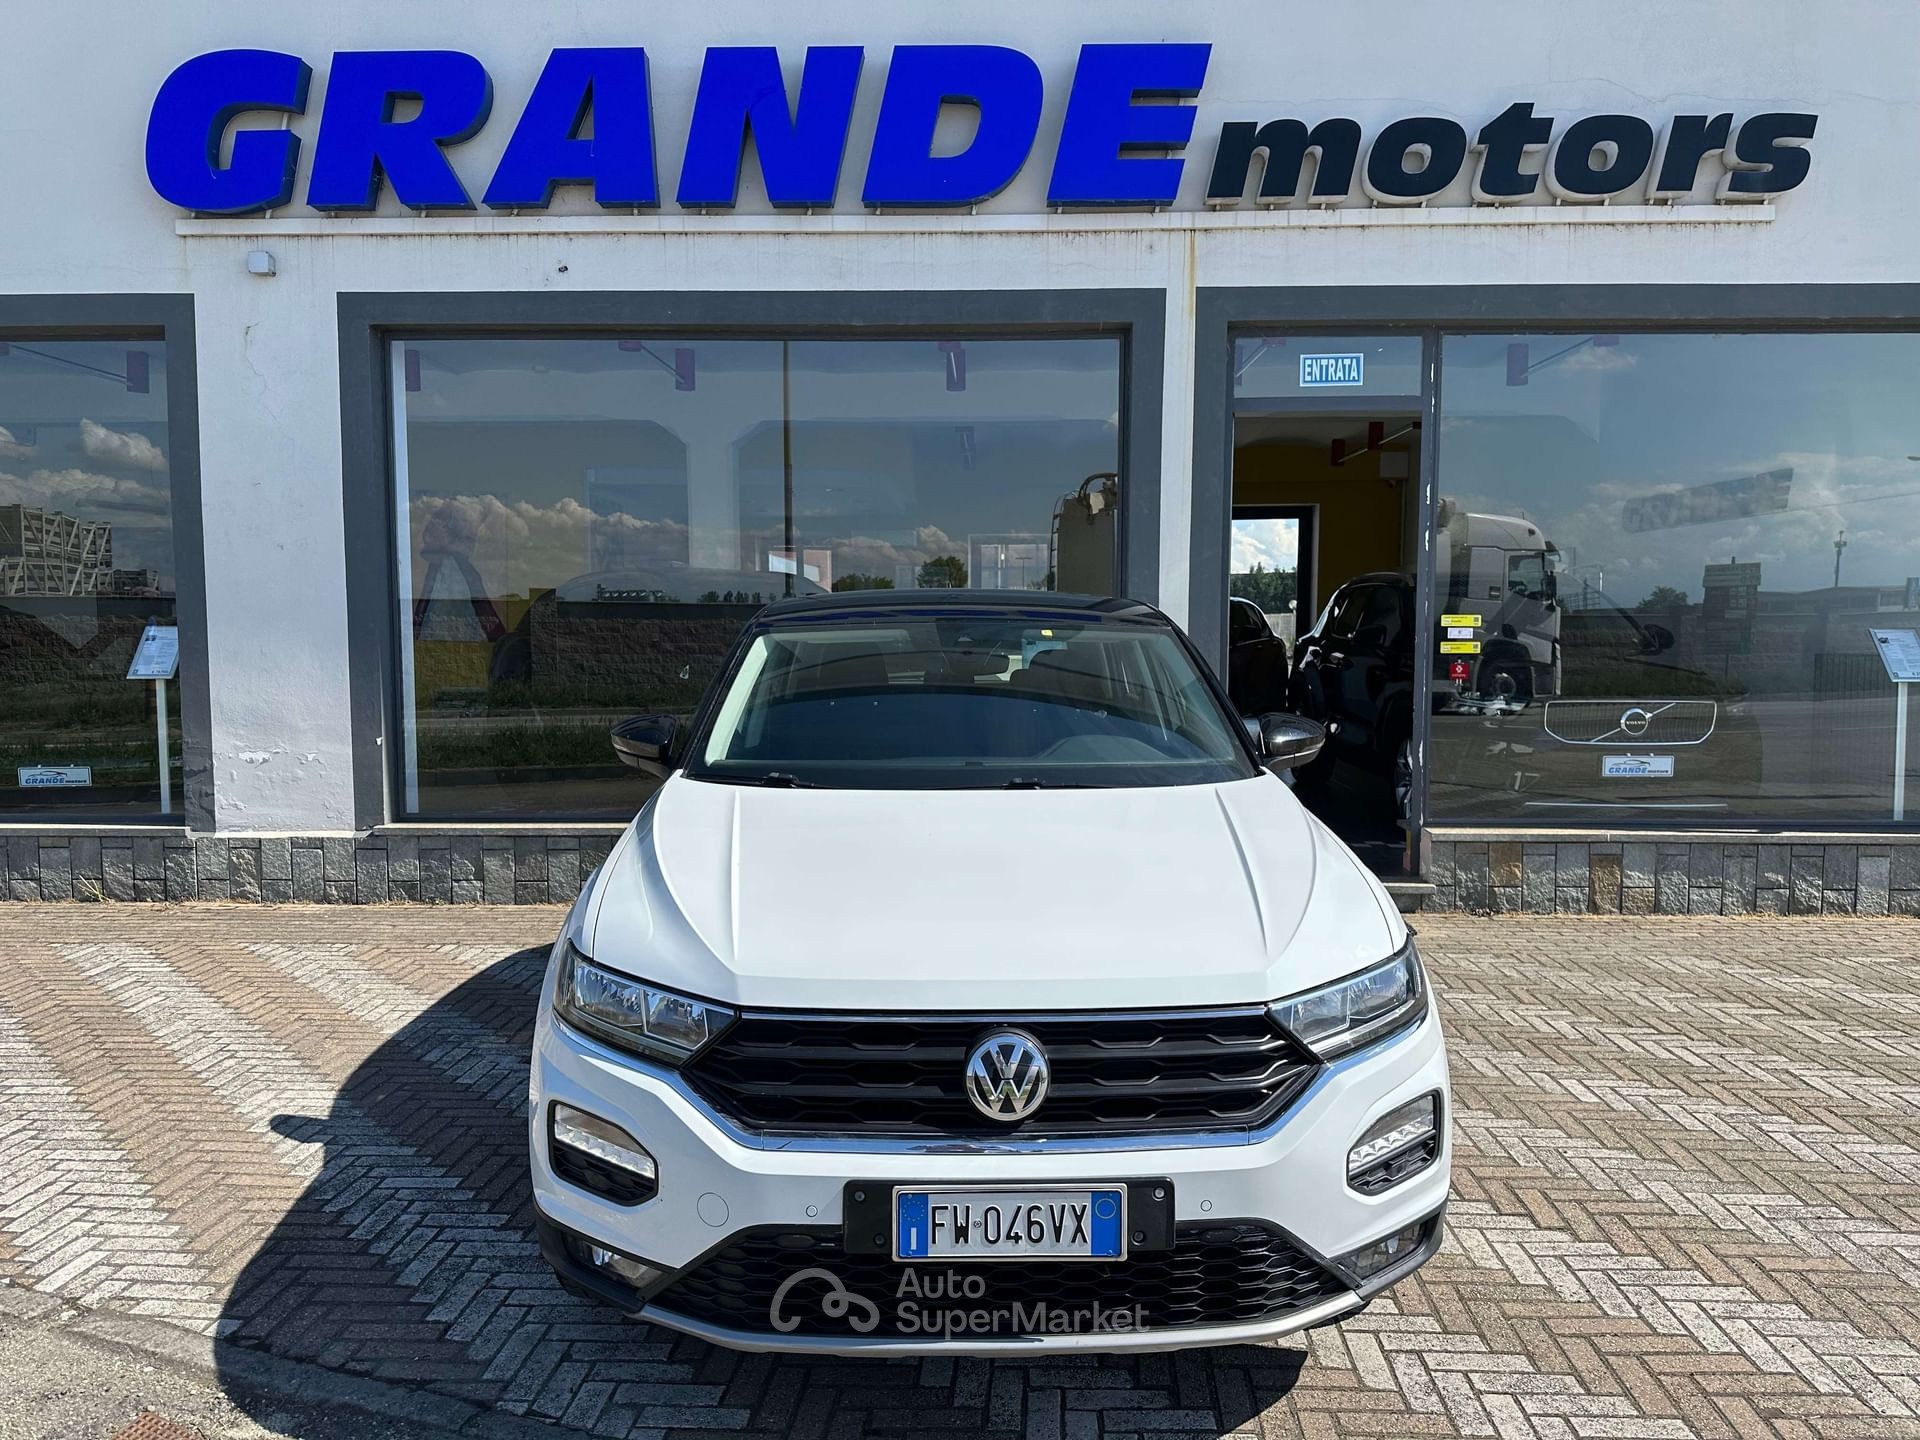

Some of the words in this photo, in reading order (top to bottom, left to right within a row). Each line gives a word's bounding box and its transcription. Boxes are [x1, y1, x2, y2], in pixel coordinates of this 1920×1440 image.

[146, 43, 1212, 215] GRANDE
[1205, 102, 1818, 203] motors
[1304, 358, 1359, 382] ENTRATA
[1608, 766, 1648, 774] GRANDE
[25, 777, 65, 785] GRANDE
